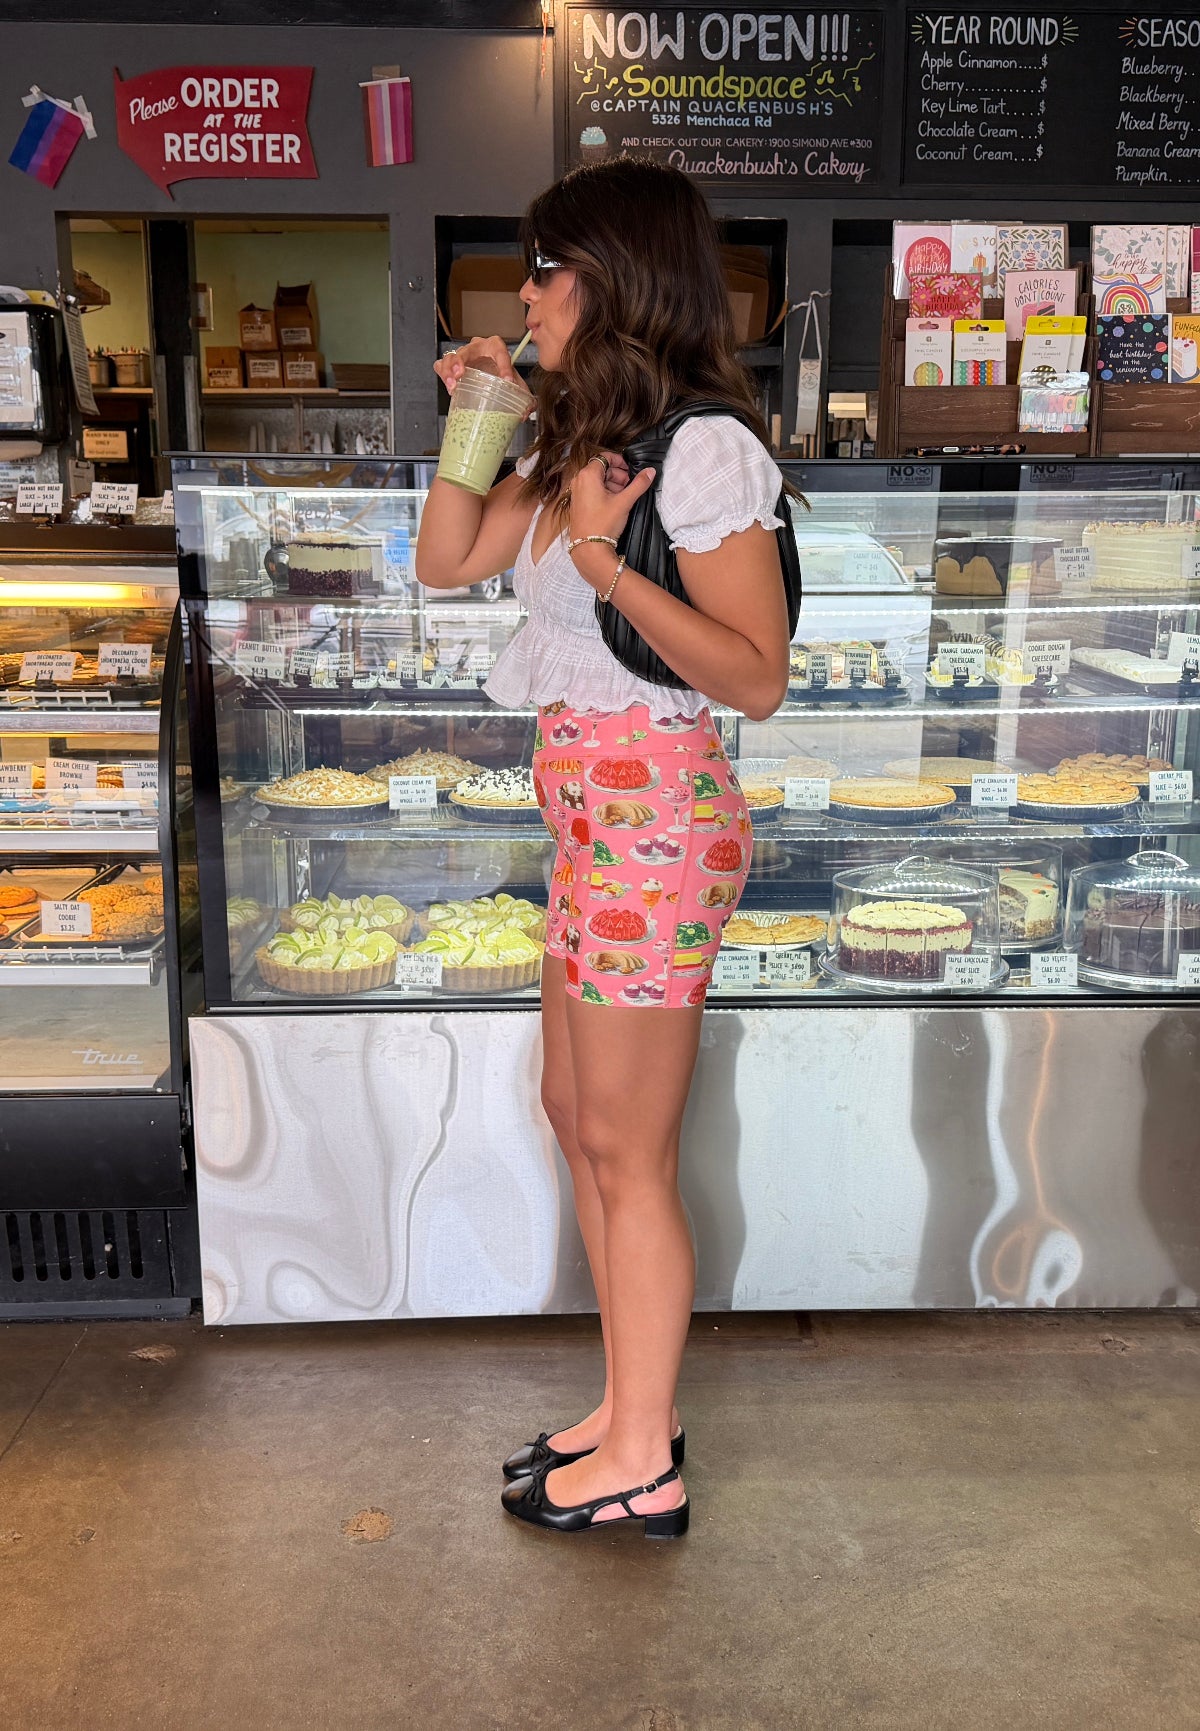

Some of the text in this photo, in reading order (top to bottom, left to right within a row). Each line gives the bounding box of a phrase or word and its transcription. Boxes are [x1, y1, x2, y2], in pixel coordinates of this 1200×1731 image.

[583, 12, 850, 62] NOW OPEN!!!
[925, 16, 1058, 46] YEAR ROUND
[921, 51, 953, 74] Apple
[180, 78, 280, 109] ORDER
[623, 65, 806, 108] Soundspace
[129, 93, 179, 125] Please
[688, 100, 833, 115] QUACKENBUSH'S
[922, 99, 945, 118] Key
[949, 100, 978, 113] Lime
[203, 114, 262, 129] AT THE
[652, 114, 772, 127] 5326 Menchaca Rd
[1116, 112, 1154, 131] Mixed
[918, 121, 1017, 138] Chocolate Cream
[164, 133, 301, 164] REGISTER
[621, 138, 640, 146] AND
[642, 138, 675, 146] CHECK
[678, 138, 697, 146] OUT
[701, 138, 721, 147] OUR
[792, 139, 829, 148] SIMOND
[831, 139, 849, 148] AVE
[1116, 141, 1160, 158] Banana
[916, 144, 1013, 161] Coconut Cream
[668, 149, 798, 176] Quackenbush's
[805, 153, 870, 183] Cakery
[1109, 253, 1148, 273] happy
[1018, 279, 1060, 294] CALORIES
[1040, 292, 1066, 302] COUNT
[1109, 349, 1154, 359] best birthday
[890, 466, 914, 476] NO
[238, 642, 282, 653] PEANUT BUTTER
[72, 762, 90, 770] CHEESE
